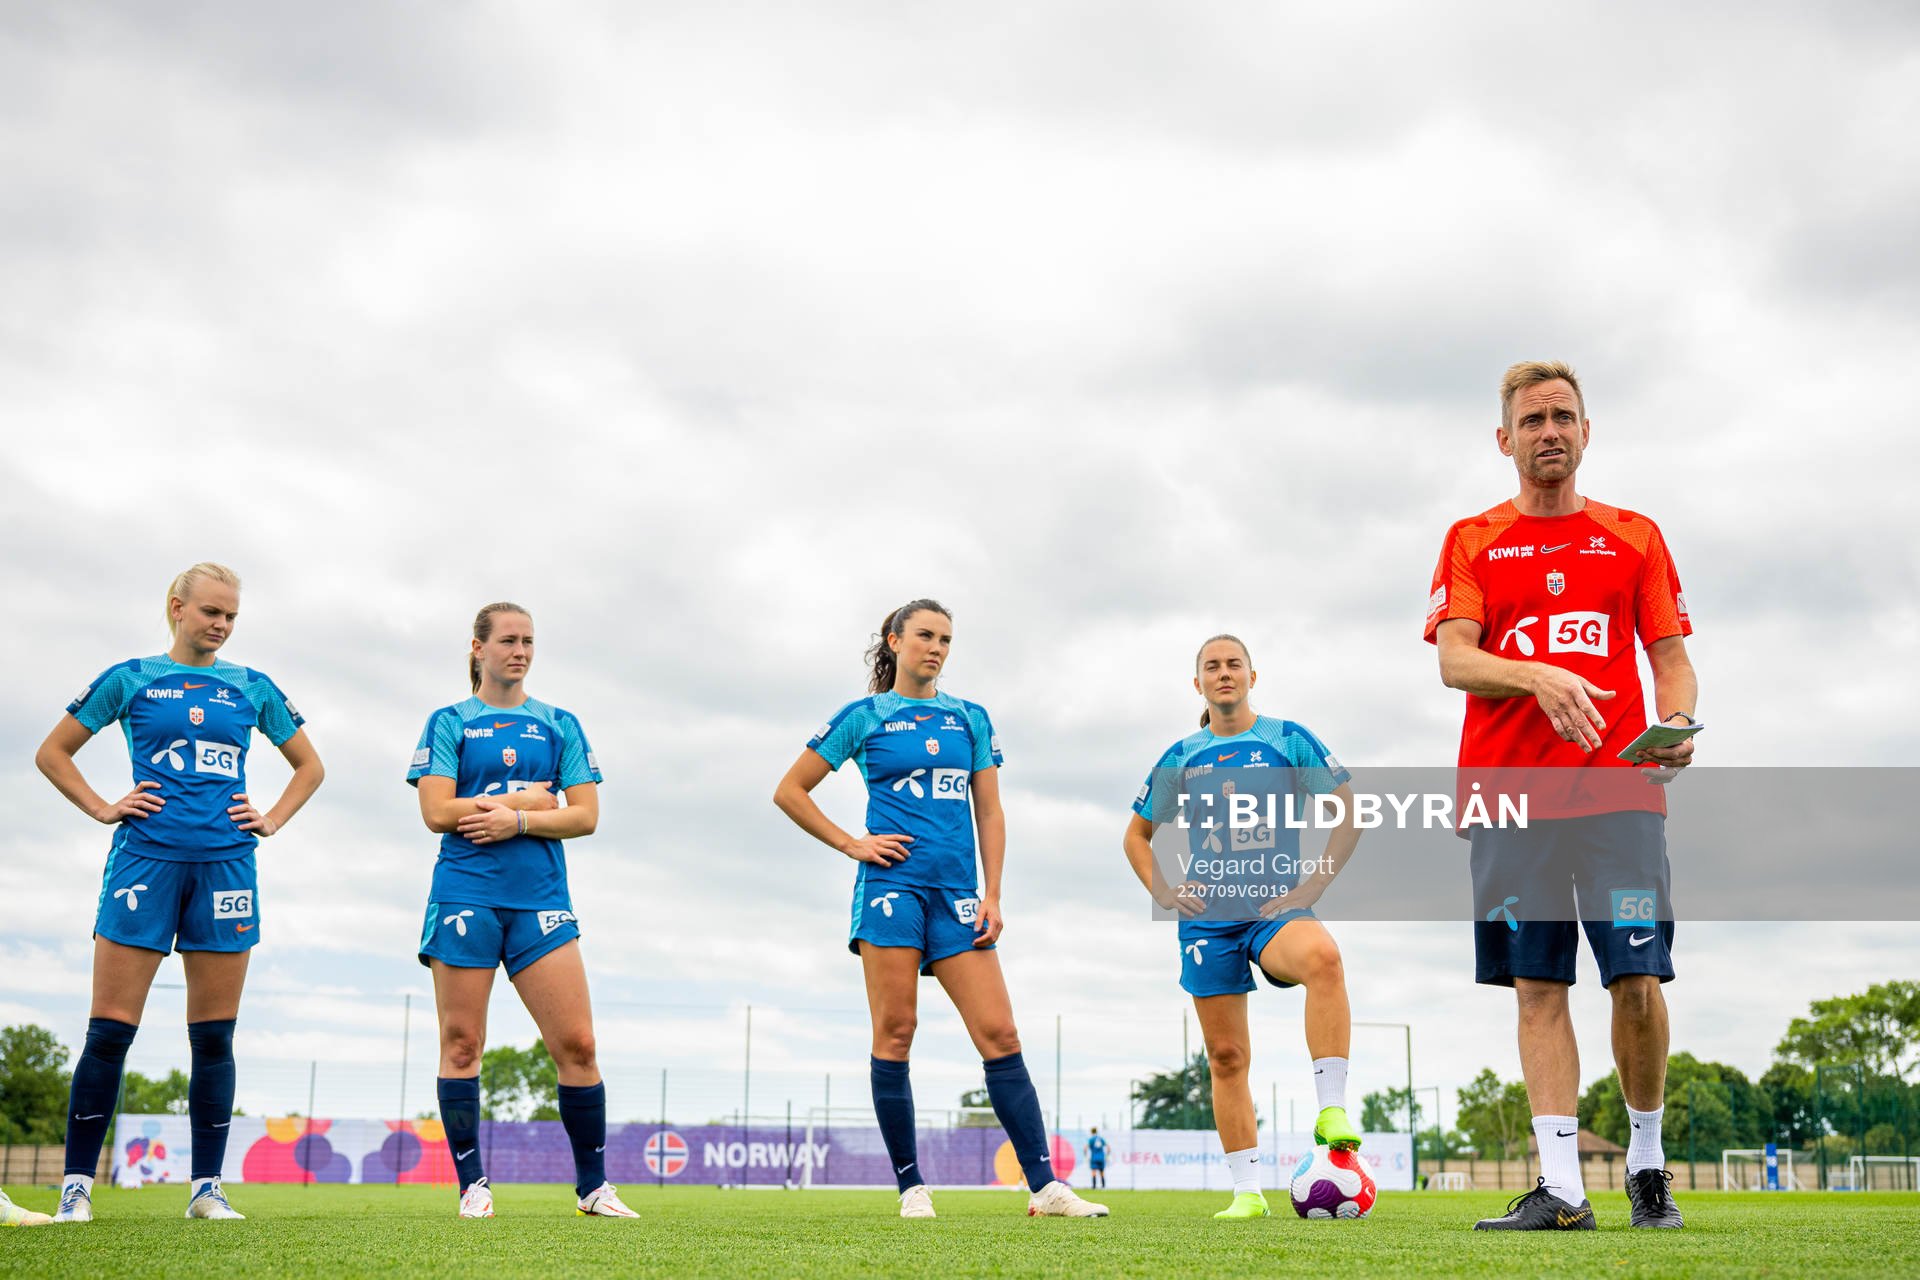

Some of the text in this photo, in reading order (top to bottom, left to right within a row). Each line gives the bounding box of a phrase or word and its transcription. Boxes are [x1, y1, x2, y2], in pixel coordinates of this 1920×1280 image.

[1488, 546, 1519, 561] KIWI
[1556, 619, 1602, 647] 5G
[146, 689, 172, 699] KIWI
[885, 720, 907, 732] KIWI
[202, 749, 234, 770] 5G
[937, 774, 966, 794] 5G
[1236, 823, 1270, 844] 5G
[219, 895, 249, 914] 5G
[1618, 896, 1654, 920] 5G
[704, 1142, 830, 1168] NORWAY
[1121, 1152, 1161, 1165] UEFA
[1163, 1153, 1224, 1166] WOMEN'
